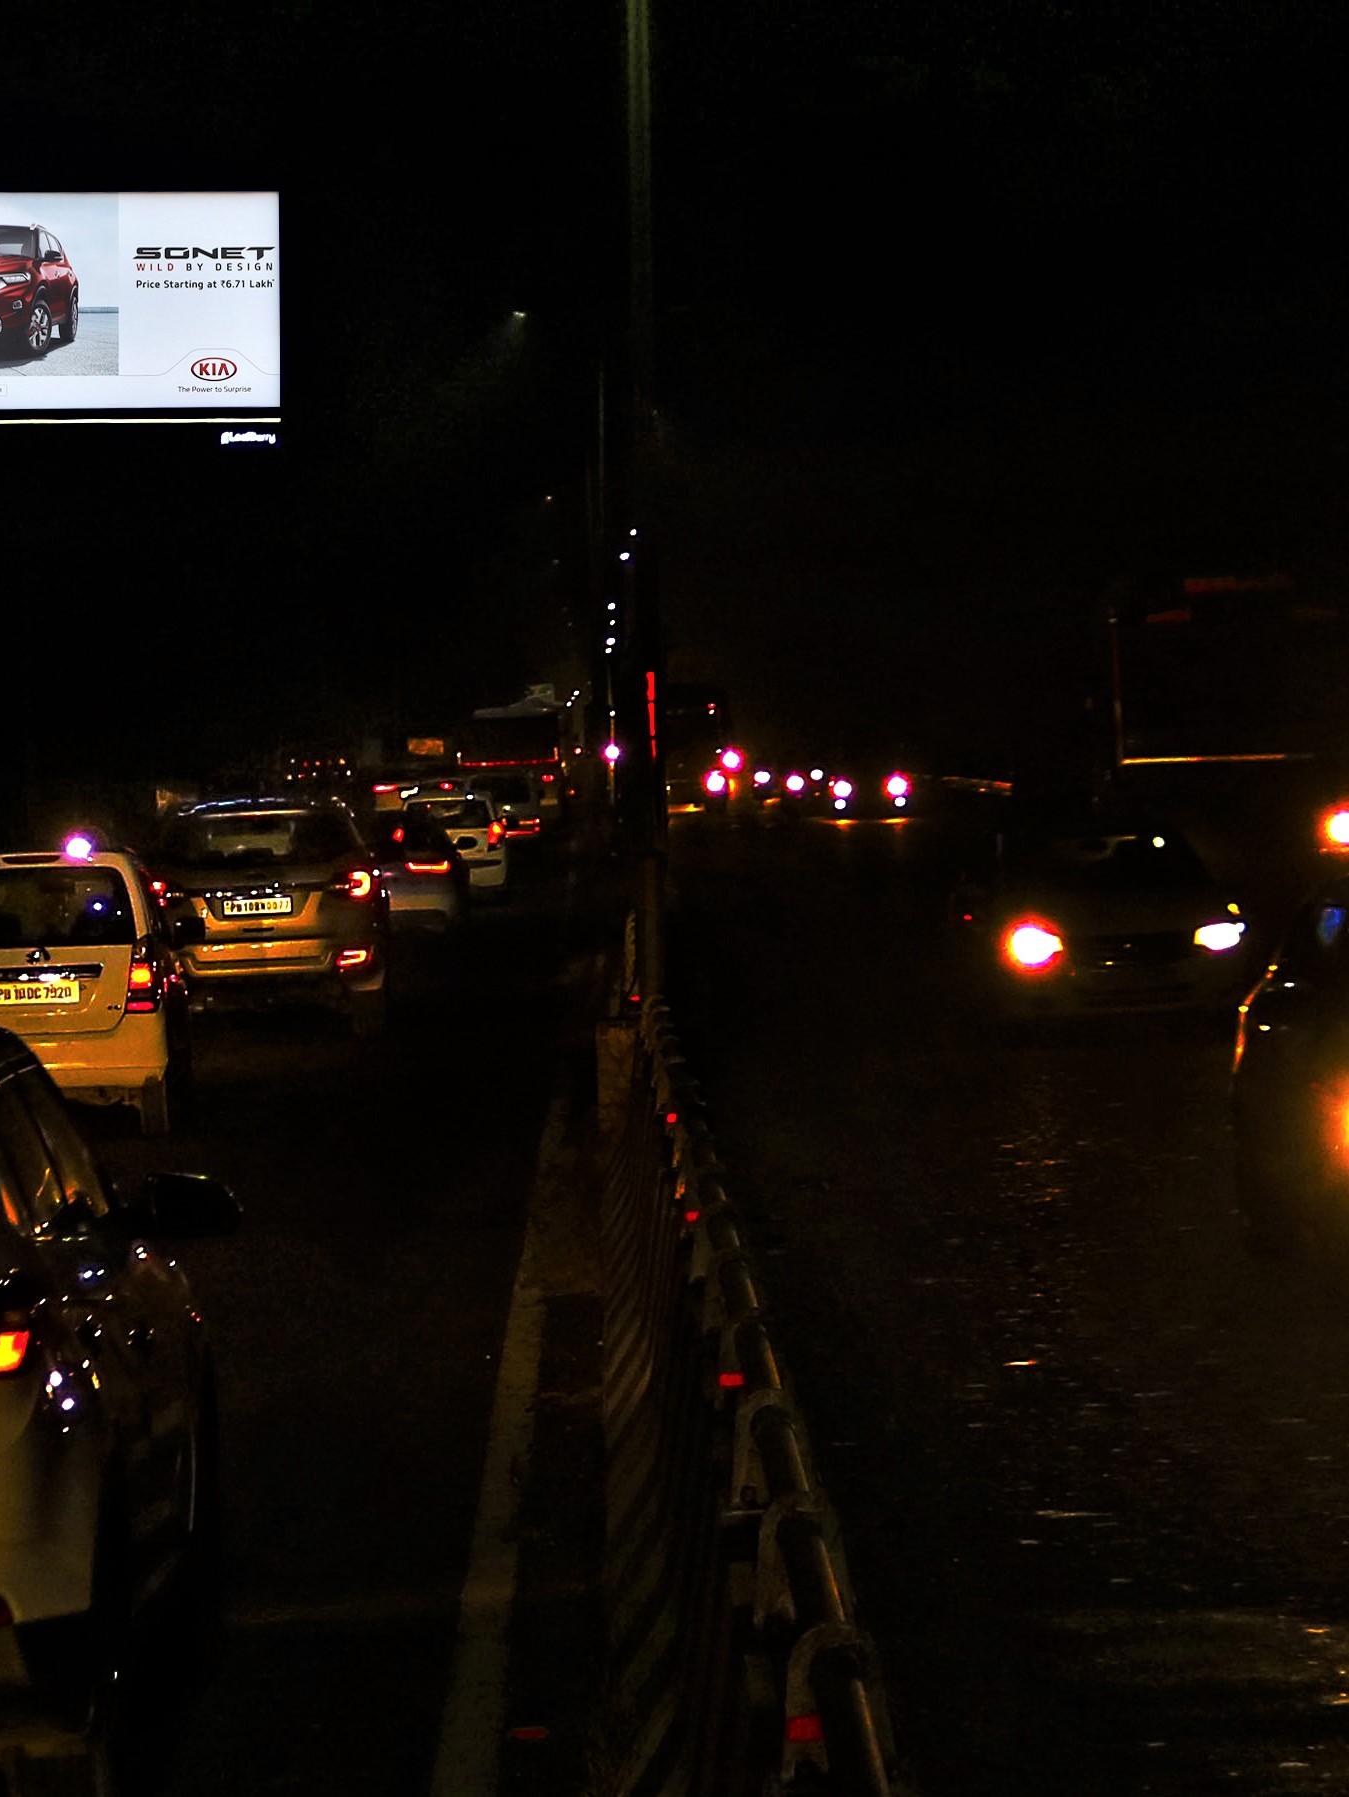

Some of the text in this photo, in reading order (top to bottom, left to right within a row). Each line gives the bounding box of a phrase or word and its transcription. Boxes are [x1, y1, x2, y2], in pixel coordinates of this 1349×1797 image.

[133, 247, 275, 260] SONET
[136, 263, 273, 271] WILD BY DESIGN
[136, 280, 161, 289] Price
[164, 280, 204, 290] Starting
[221, 280, 245, 288] ₹6.71
[199, 363, 229, 376] KIA
[192, 385, 213, 393] Power
[224, 385, 252, 393] Surprise
